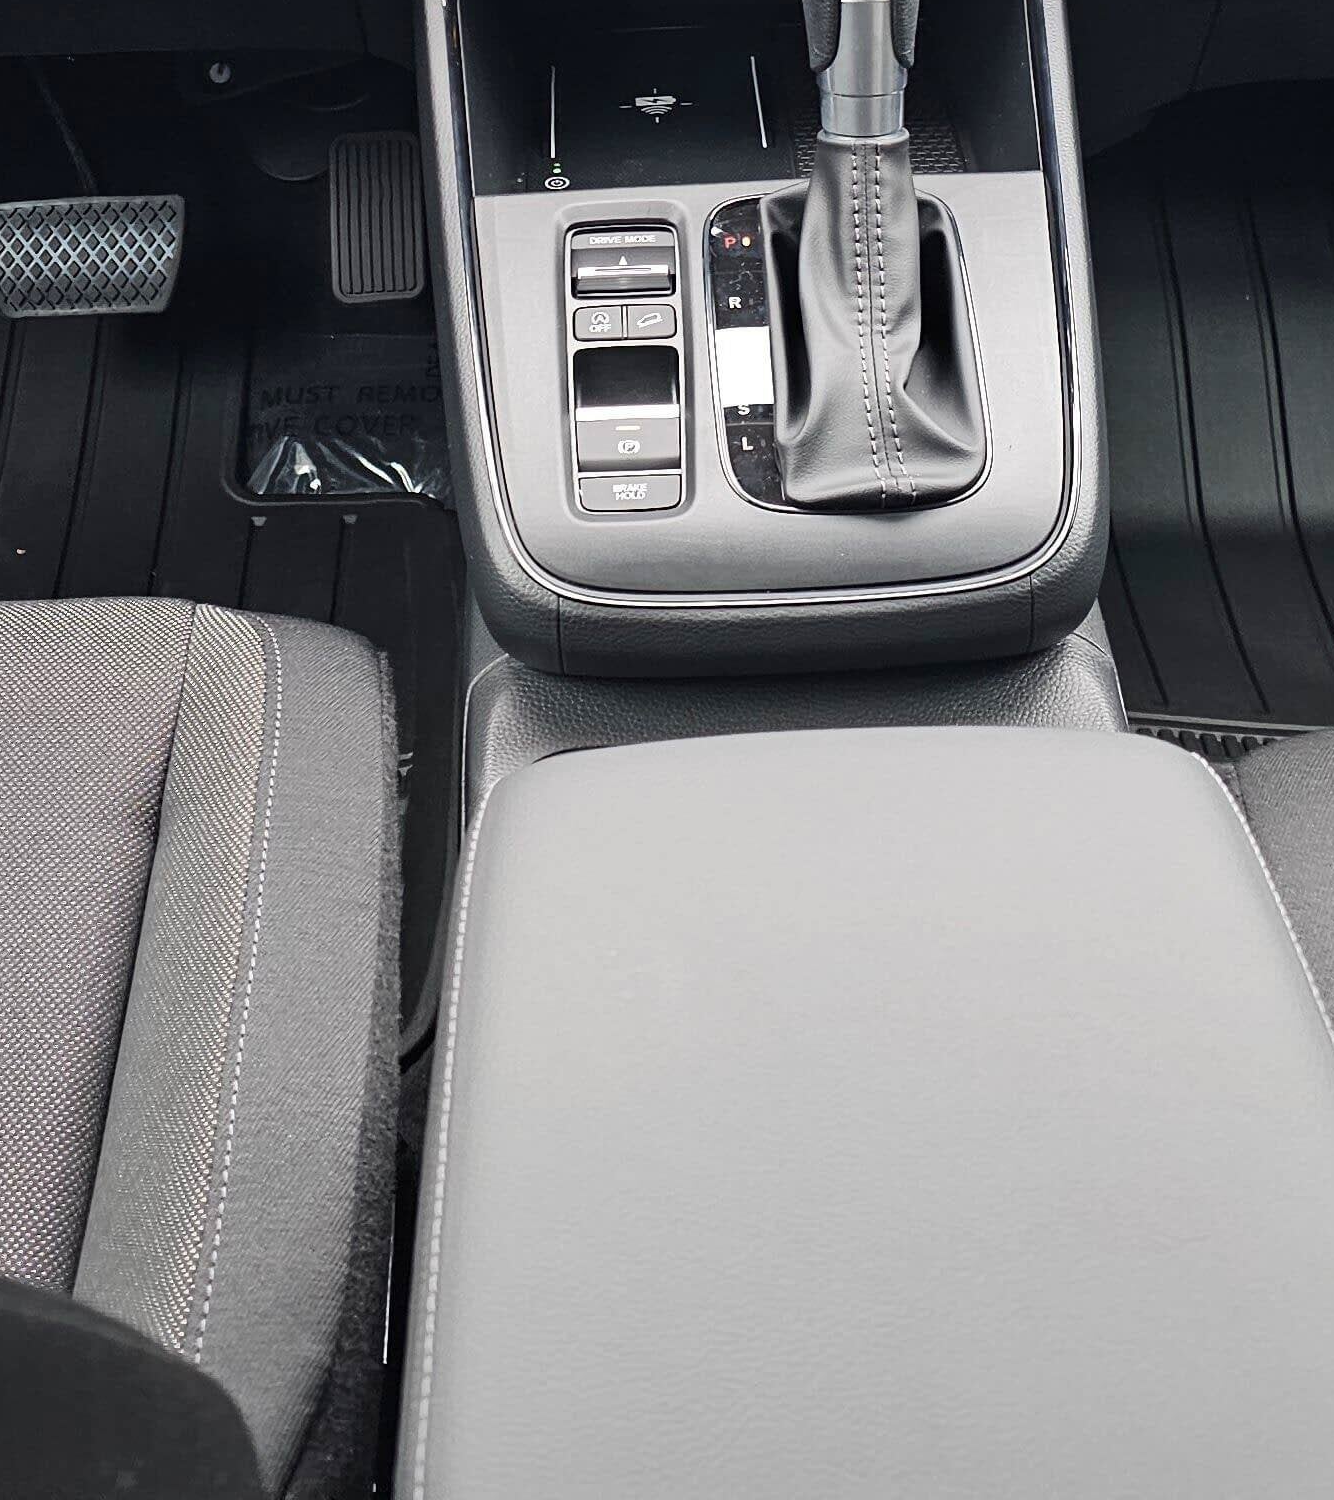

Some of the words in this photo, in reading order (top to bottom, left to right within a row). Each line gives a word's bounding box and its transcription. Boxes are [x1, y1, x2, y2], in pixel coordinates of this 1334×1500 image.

[589, 235, 622, 245] DRIVE
[624, 234, 657, 244] MODE
[724, 236, 737, 249] P
[728, 296, 742, 309] R
[588, 324, 612, 333] OFF
[261, 386, 341, 405] MUST
[313, 414, 420, 437] COVER
[741, 436, 754, 451] L
[612, 482, 648, 493] BRAKE
[615, 490, 646, 501] HOLD
